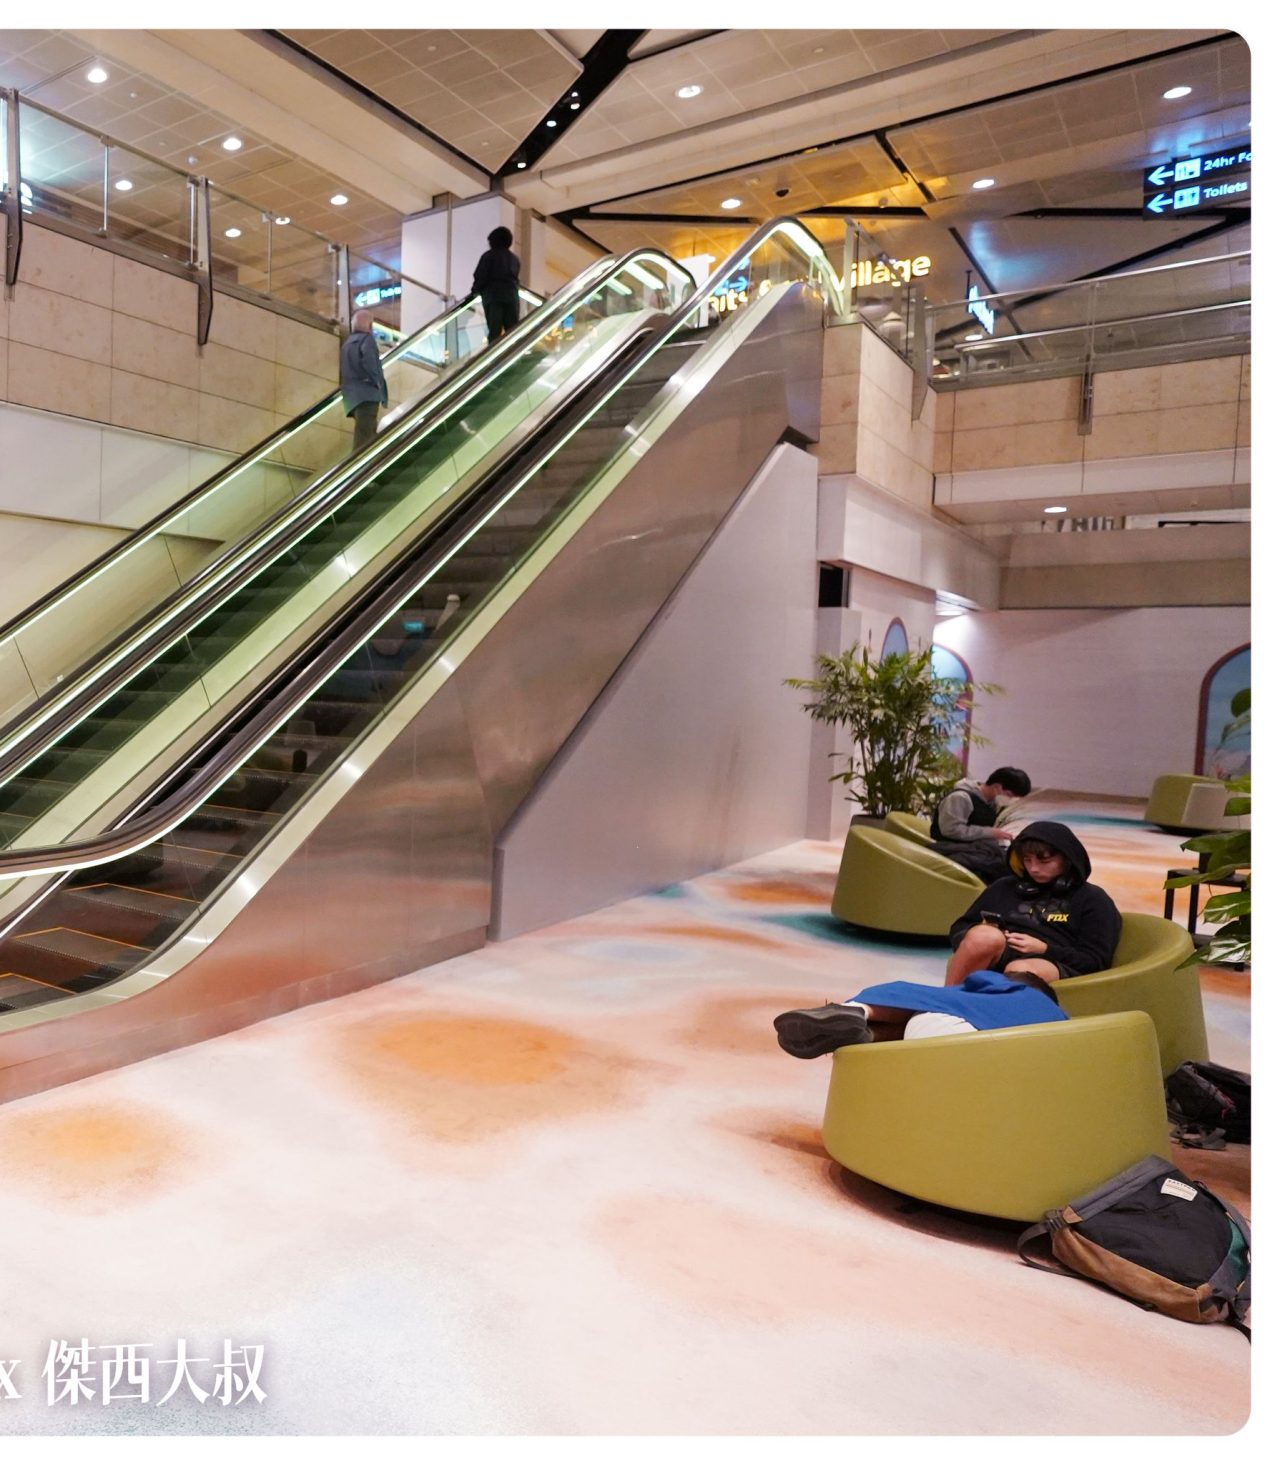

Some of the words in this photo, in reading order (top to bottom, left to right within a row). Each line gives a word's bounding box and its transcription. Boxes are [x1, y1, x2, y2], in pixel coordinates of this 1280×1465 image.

[1203, 155, 1235, 171] 24hr
[1203, 182, 1248, 198] Toilets
[1047, 914, 1069, 922] FOX
